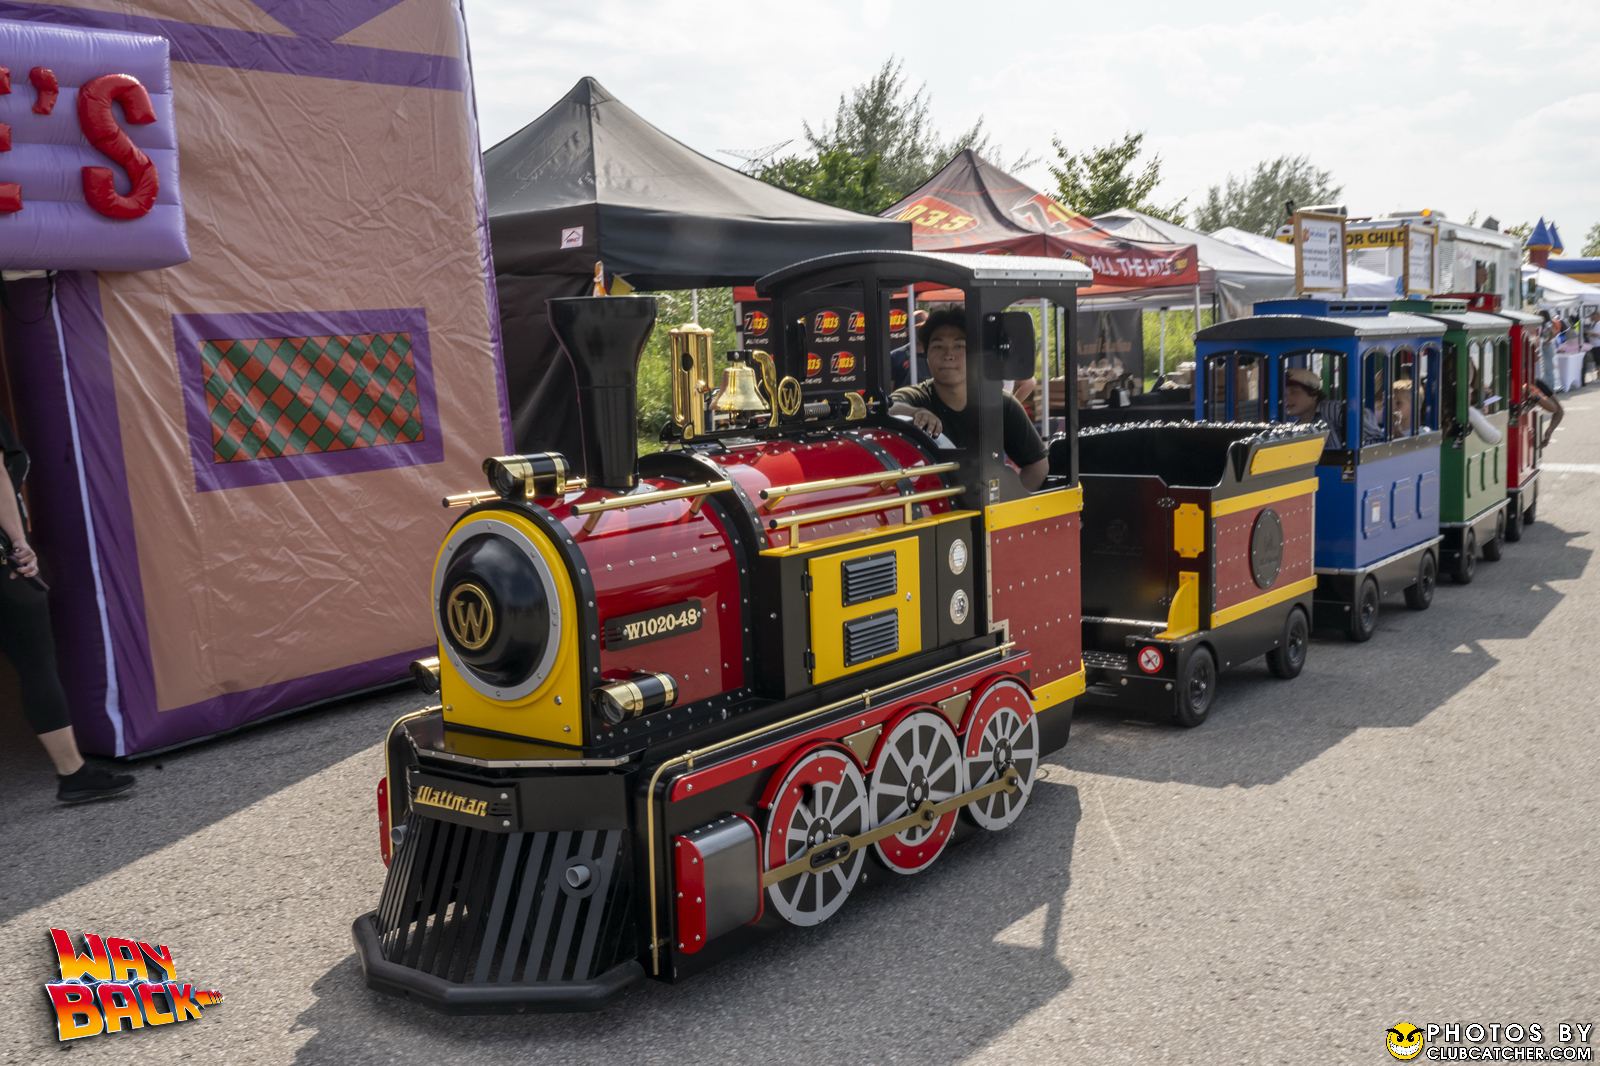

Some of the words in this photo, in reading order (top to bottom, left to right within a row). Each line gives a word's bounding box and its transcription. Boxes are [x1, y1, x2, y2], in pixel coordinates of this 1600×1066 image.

[1345, 234, 1364, 245] OR
[1367, 231, 1406, 244] CHILD
[1091, 255, 1119, 276] ALL
[1116, 257, 1147, 277] THE
[780, 380, 800, 412] W
[450, 588, 491, 648] W
[625, 608, 698, 641] W1020-48
[414, 784, 488, 817] Wattman
